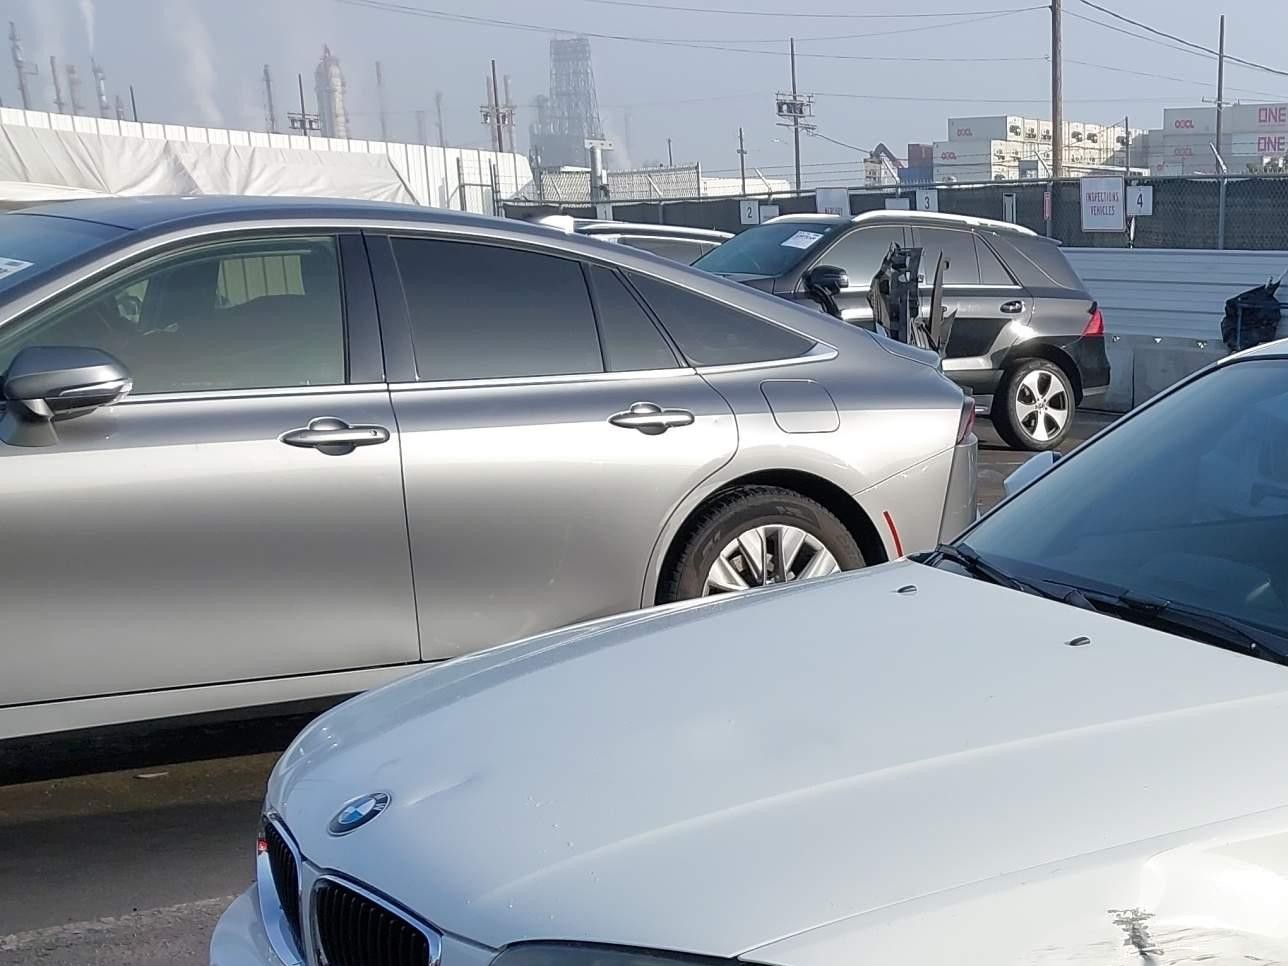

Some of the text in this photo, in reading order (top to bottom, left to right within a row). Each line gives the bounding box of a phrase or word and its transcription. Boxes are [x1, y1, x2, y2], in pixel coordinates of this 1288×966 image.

[1258, 107, 1287, 123] ONE
[1257, 136, 1286, 152] ONE
[924, 196, 930, 209] 3
[1085, 191, 1119, 202] INSPECTIONS
[1136, 193, 1144, 208] 4
[747, 206, 753, 218] 2
[1089, 205, 1115, 215] VEHICLES
